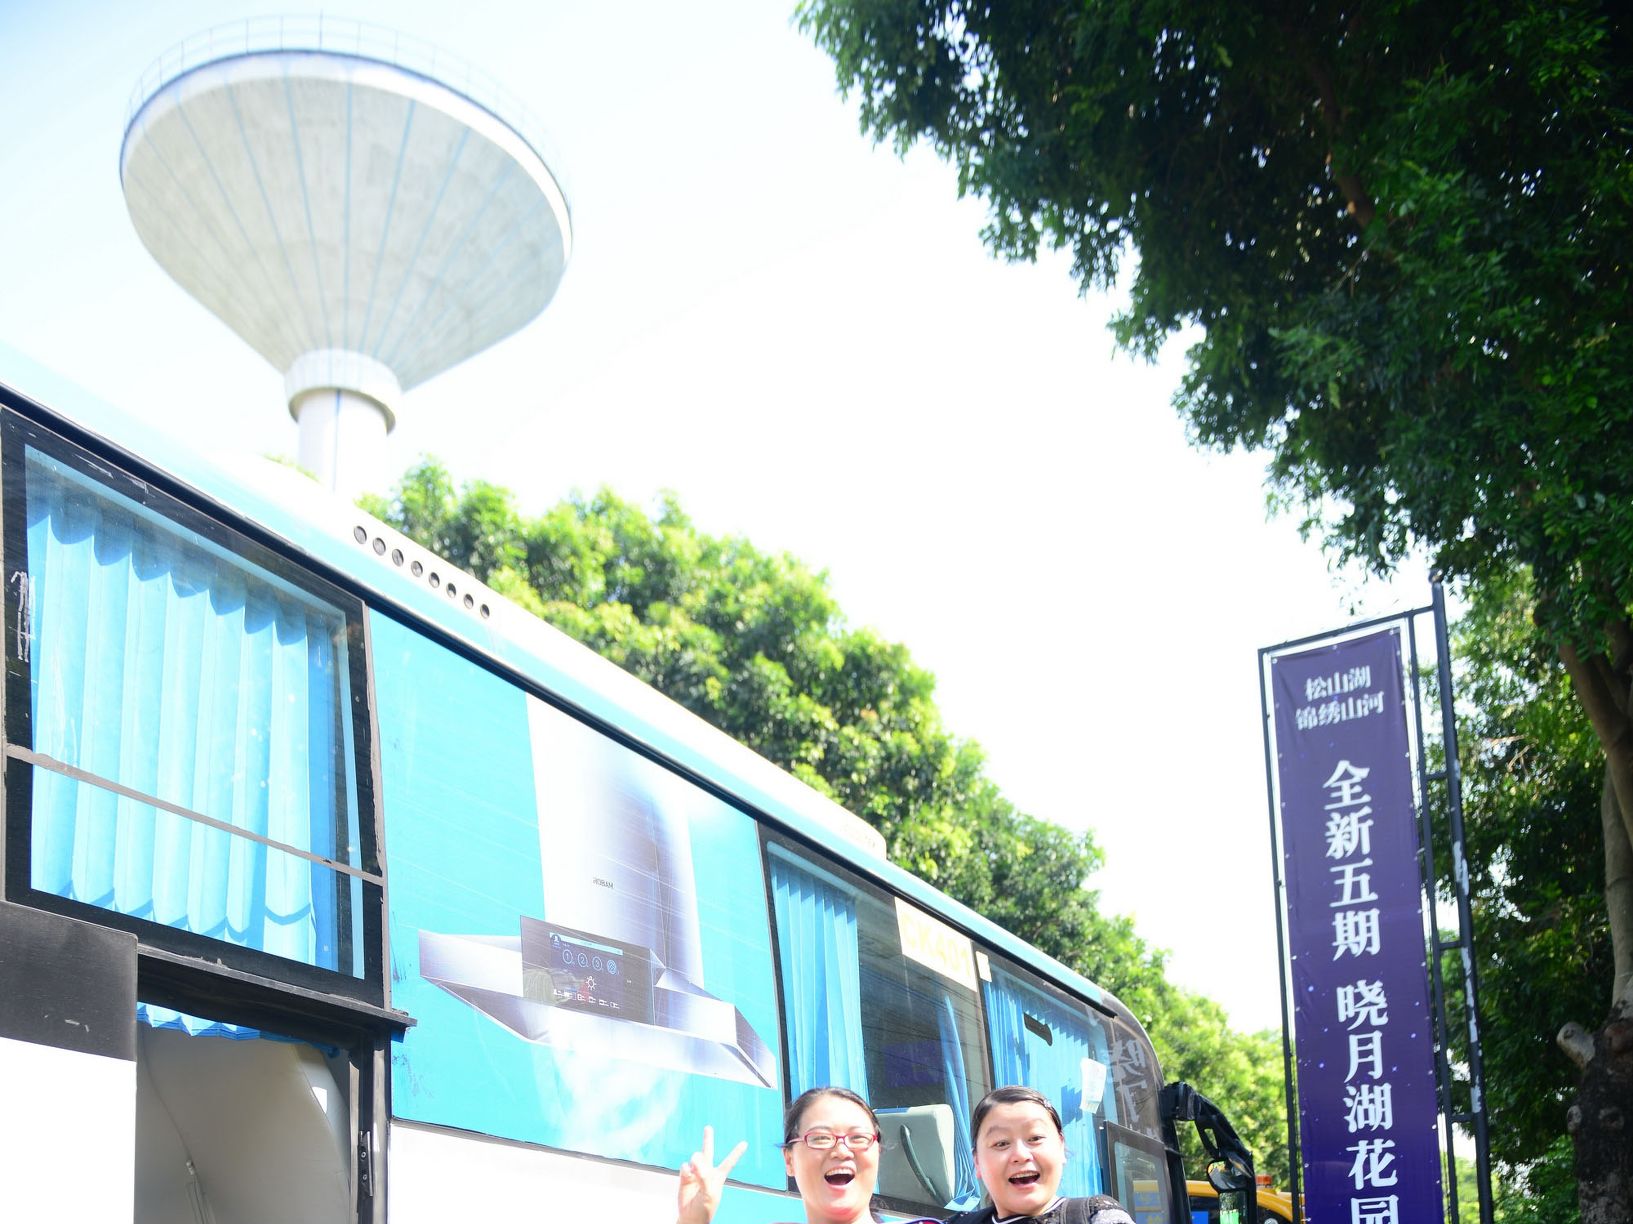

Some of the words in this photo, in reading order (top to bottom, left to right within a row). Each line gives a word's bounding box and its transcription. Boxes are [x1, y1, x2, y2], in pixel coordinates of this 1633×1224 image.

[1304, 665, 1371, 703] 松山湖
[1295, 690, 1385, 731] 锦绣山河
[1322, 759, 1381, 961] 全新五期
